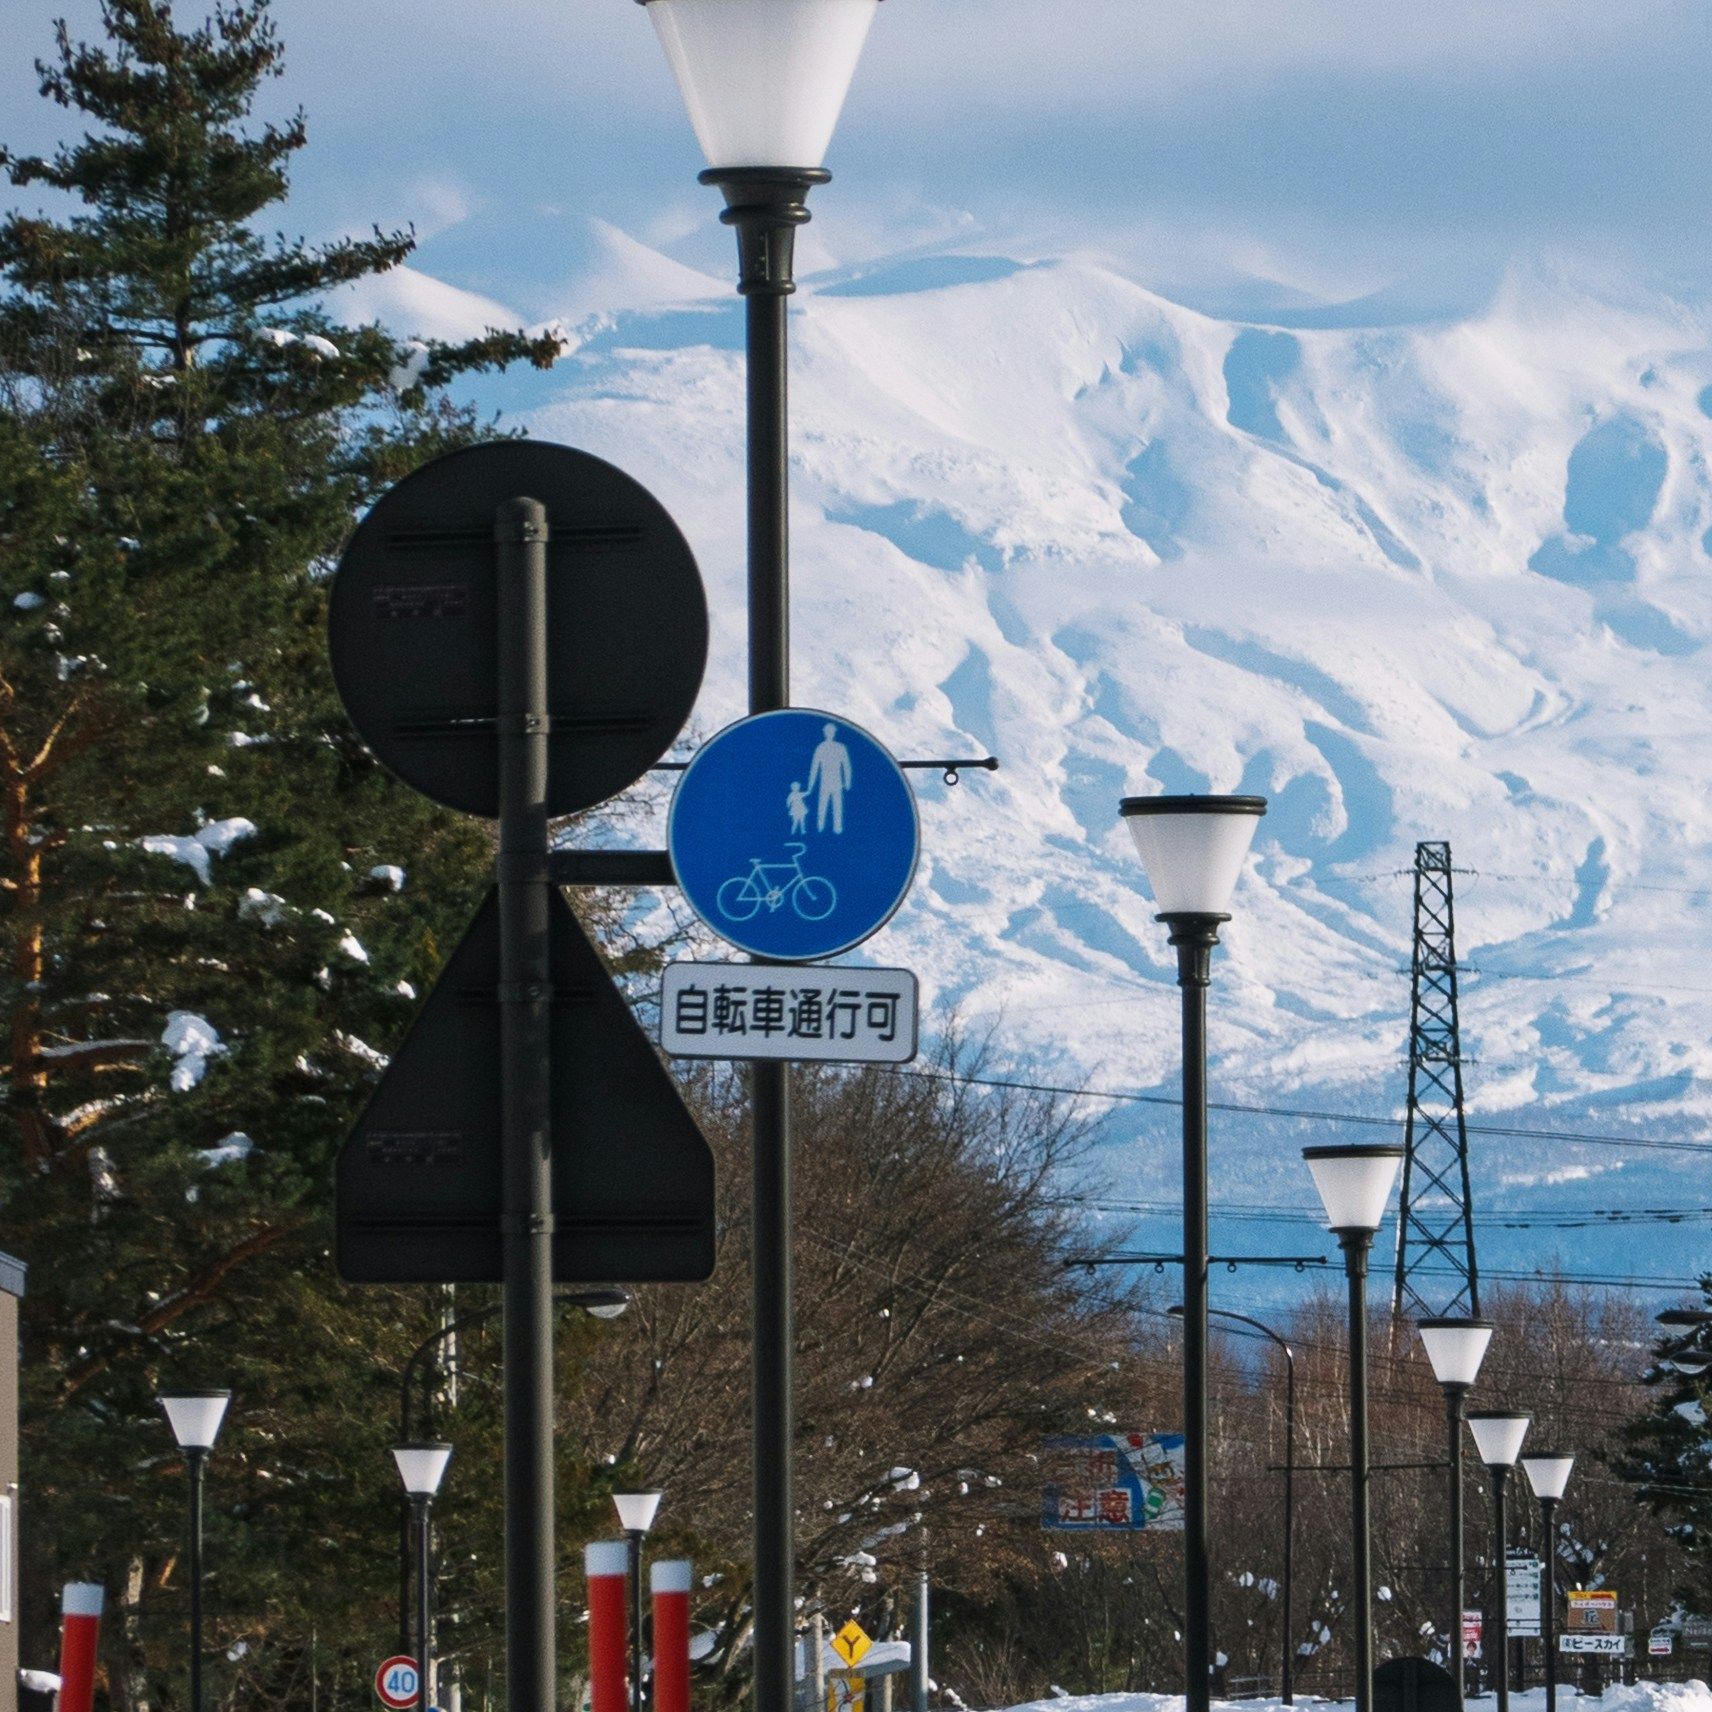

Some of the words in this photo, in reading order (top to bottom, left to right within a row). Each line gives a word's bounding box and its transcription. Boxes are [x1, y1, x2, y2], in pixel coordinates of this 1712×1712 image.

[675, 984, 901, 1042] 自転車通行可
[387, 1670, 416, 1694] 40
